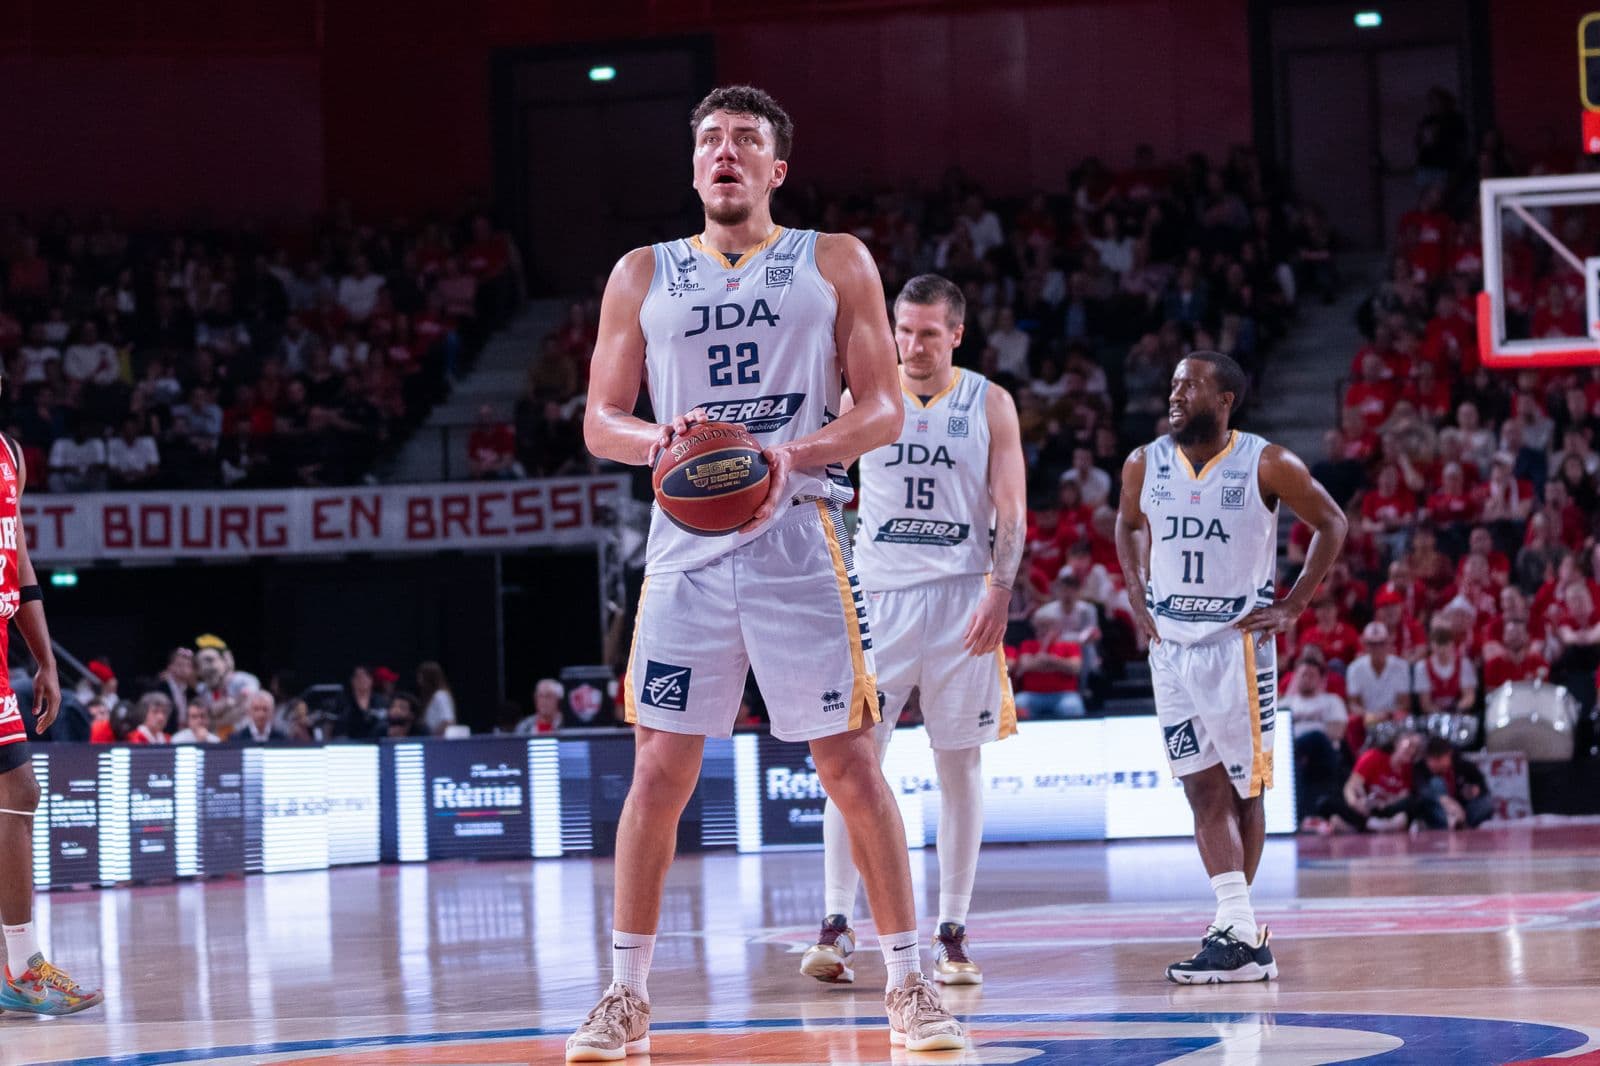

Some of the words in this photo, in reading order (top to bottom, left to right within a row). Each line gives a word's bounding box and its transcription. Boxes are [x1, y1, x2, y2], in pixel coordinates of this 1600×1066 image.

[684, 298, 780, 338] JDA
[708, 341, 760, 387] 22
[685, 455, 752, 481] LEGACY
[885, 443, 956, 469] JDA
[904, 476, 935, 510] 15
[103, 504, 288, 550] BOURG
[312, 496, 382, 541] EN
[889, 519, 961, 538] ISERBA
[1161, 516, 1231, 544] JDA
[1181, 550, 1205, 584] 11
[1169, 595, 1236, 614] ISERBA
